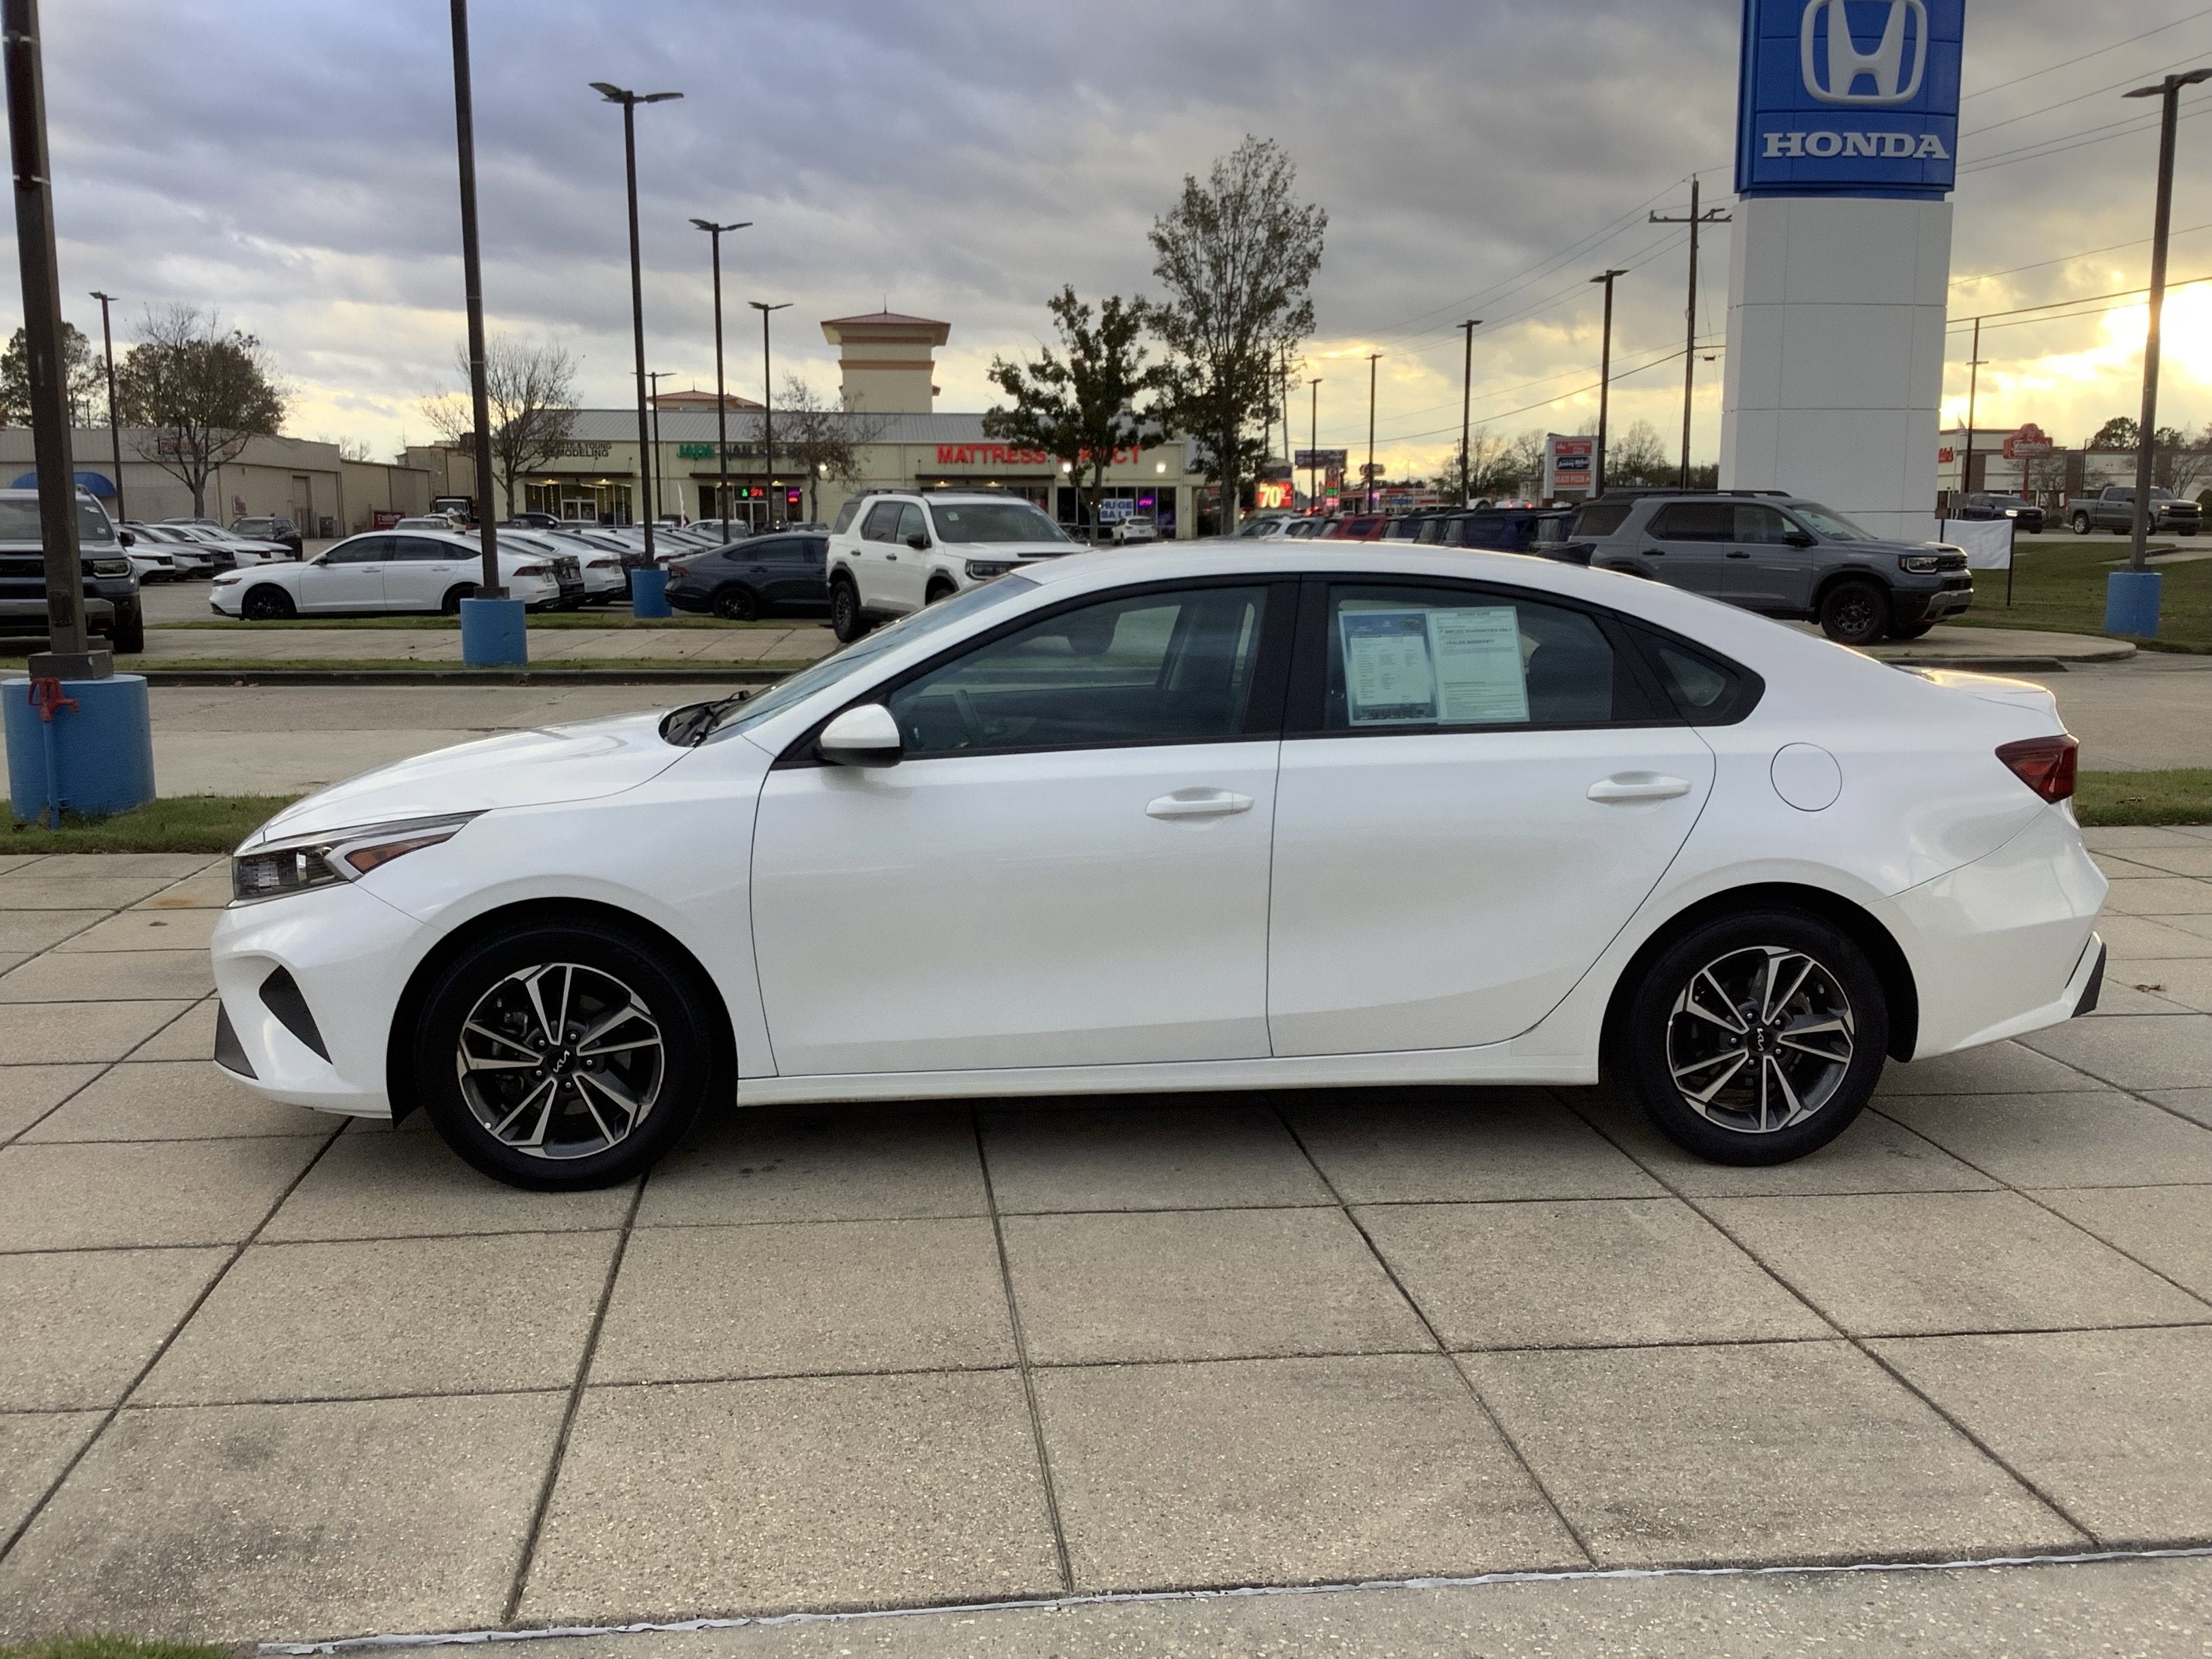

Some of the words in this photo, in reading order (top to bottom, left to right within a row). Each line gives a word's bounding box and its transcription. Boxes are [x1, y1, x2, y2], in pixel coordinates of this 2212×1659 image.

[1763, 131, 1950, 159] HONDA
[2011, 440, 2050, 451] Freddy's
[937, 445, 1047, 464] MATTRESS
[750, 488, 763, 497] SPA
[1259, 484, 1282, 508] 70
[1101, 510, 1132, 518] SALE
